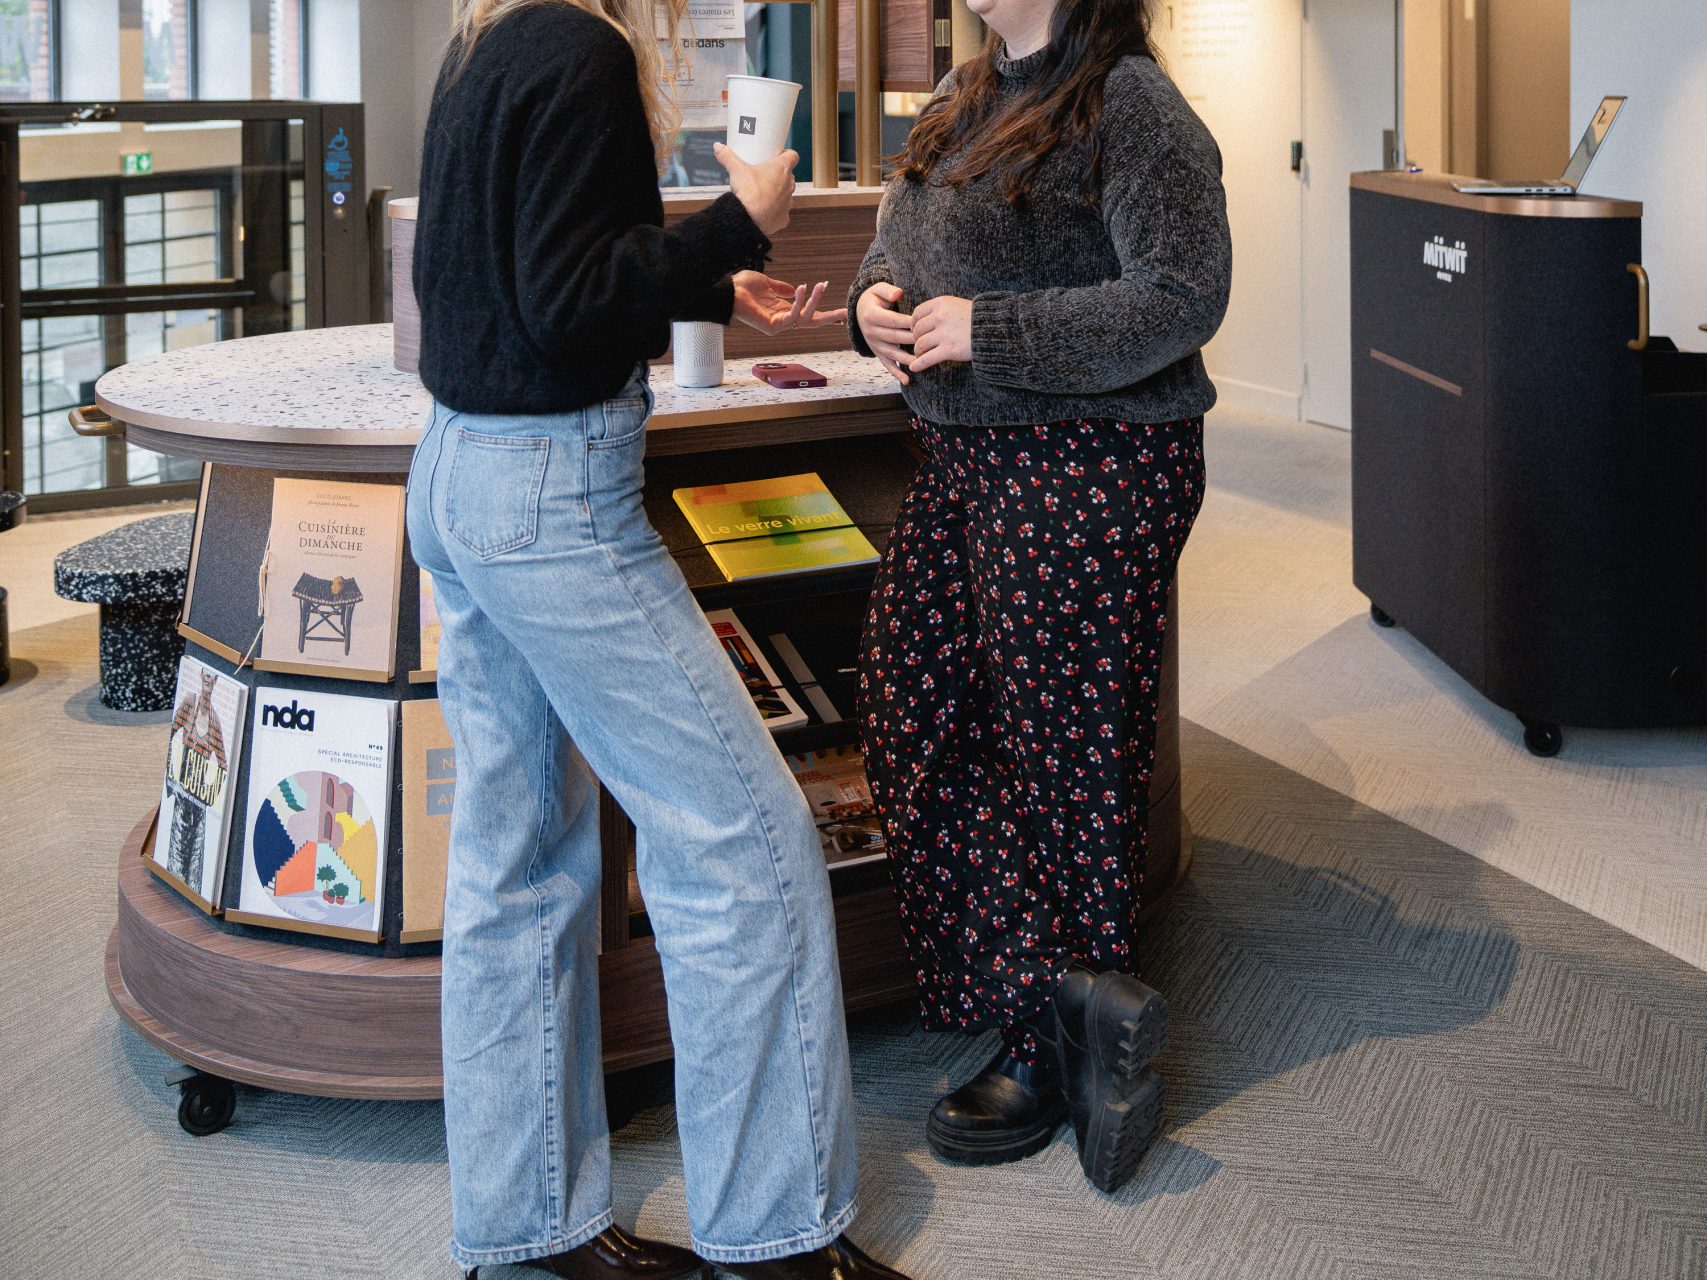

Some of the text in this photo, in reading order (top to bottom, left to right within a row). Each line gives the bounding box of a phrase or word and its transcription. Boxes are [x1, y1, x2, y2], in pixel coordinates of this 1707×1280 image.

[298, 521, 366, 536] CUISINIÈRE
[706, 511, 843, 535] Le verre vivant
[299, 538, 363, 551] DIMANCHE
[262, 699, 315, 732] nda
[342, 752, 383, 762] ARCHITECTURE
